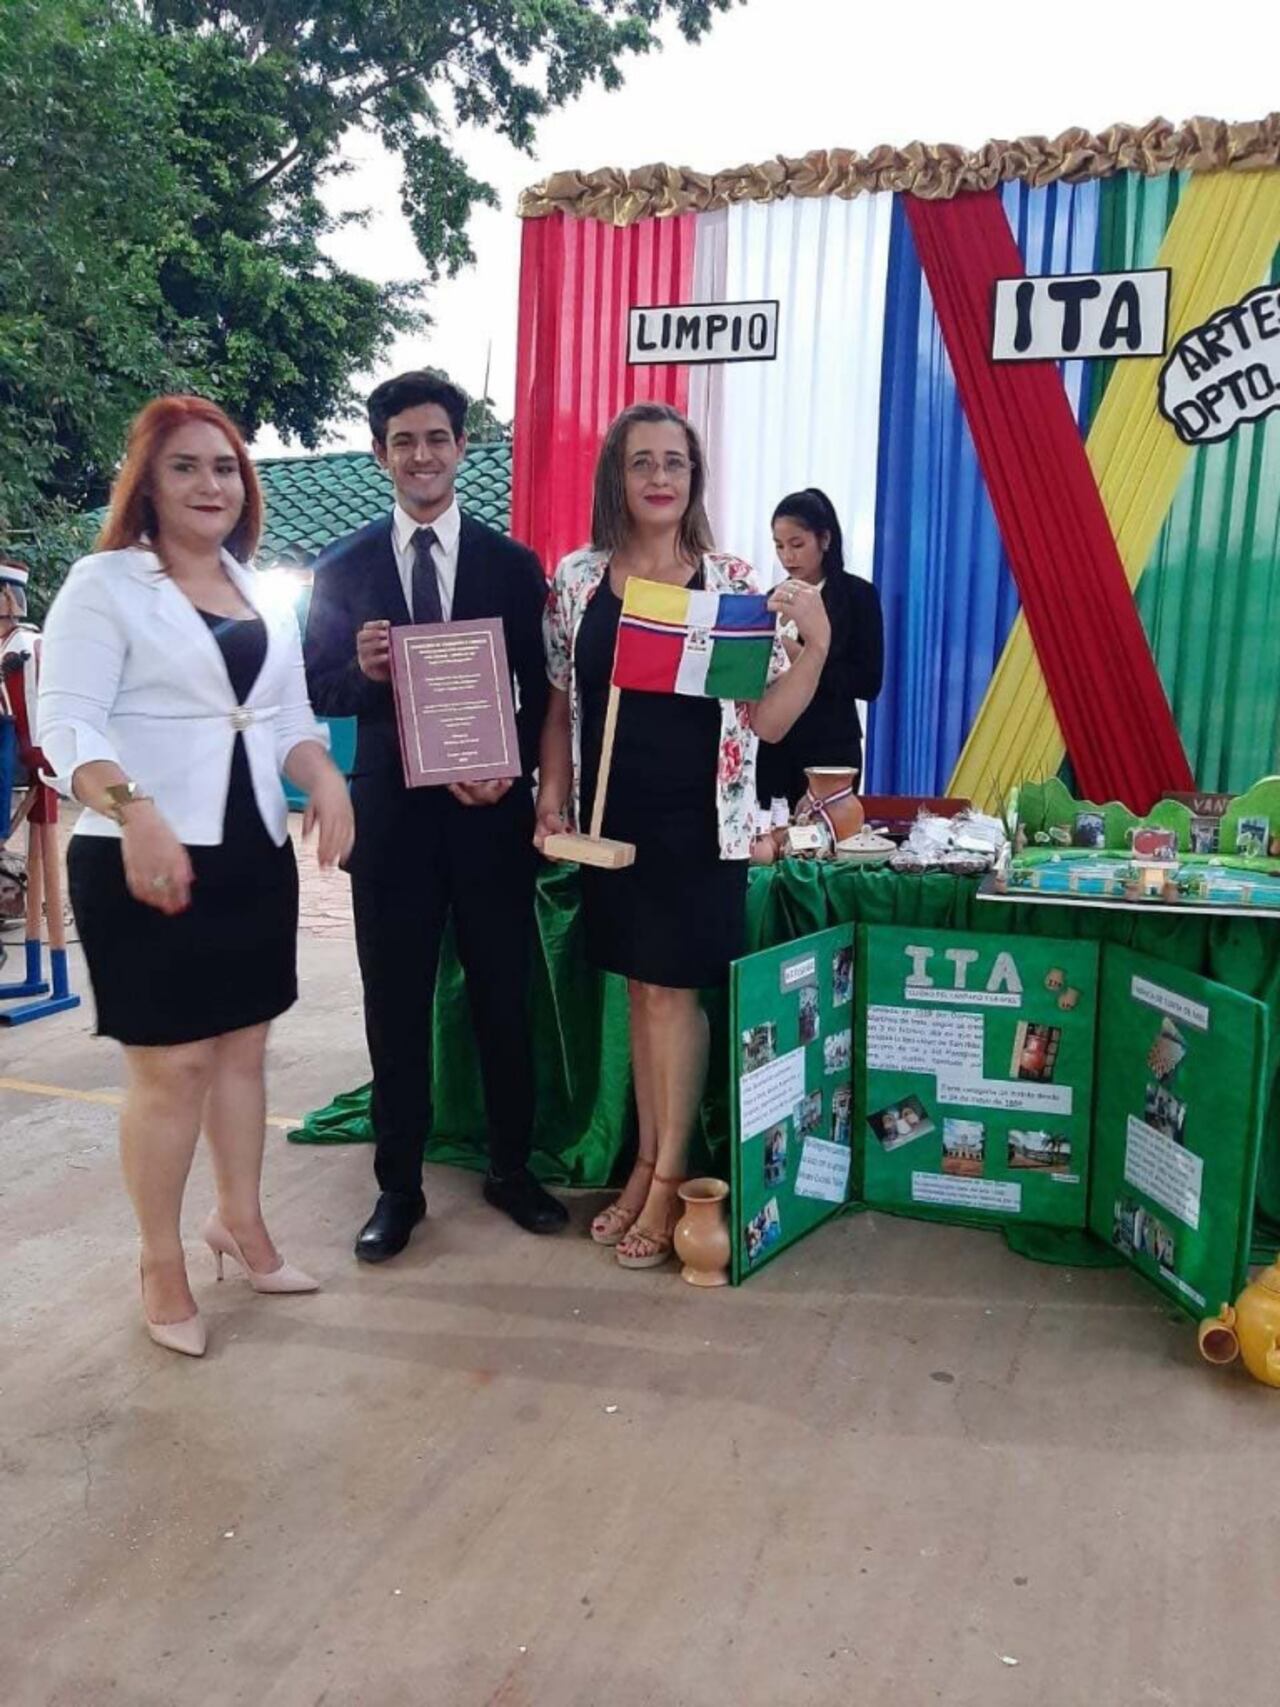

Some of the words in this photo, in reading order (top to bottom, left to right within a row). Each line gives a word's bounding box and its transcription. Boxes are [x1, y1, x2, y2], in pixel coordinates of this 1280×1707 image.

[637, 312, 768, 351] LIMPIO
[1013, 279, 1143, 352] ITA
[1177, 293, 1280, 381] ARTE
[904, 945, 1024, 993] ITA
